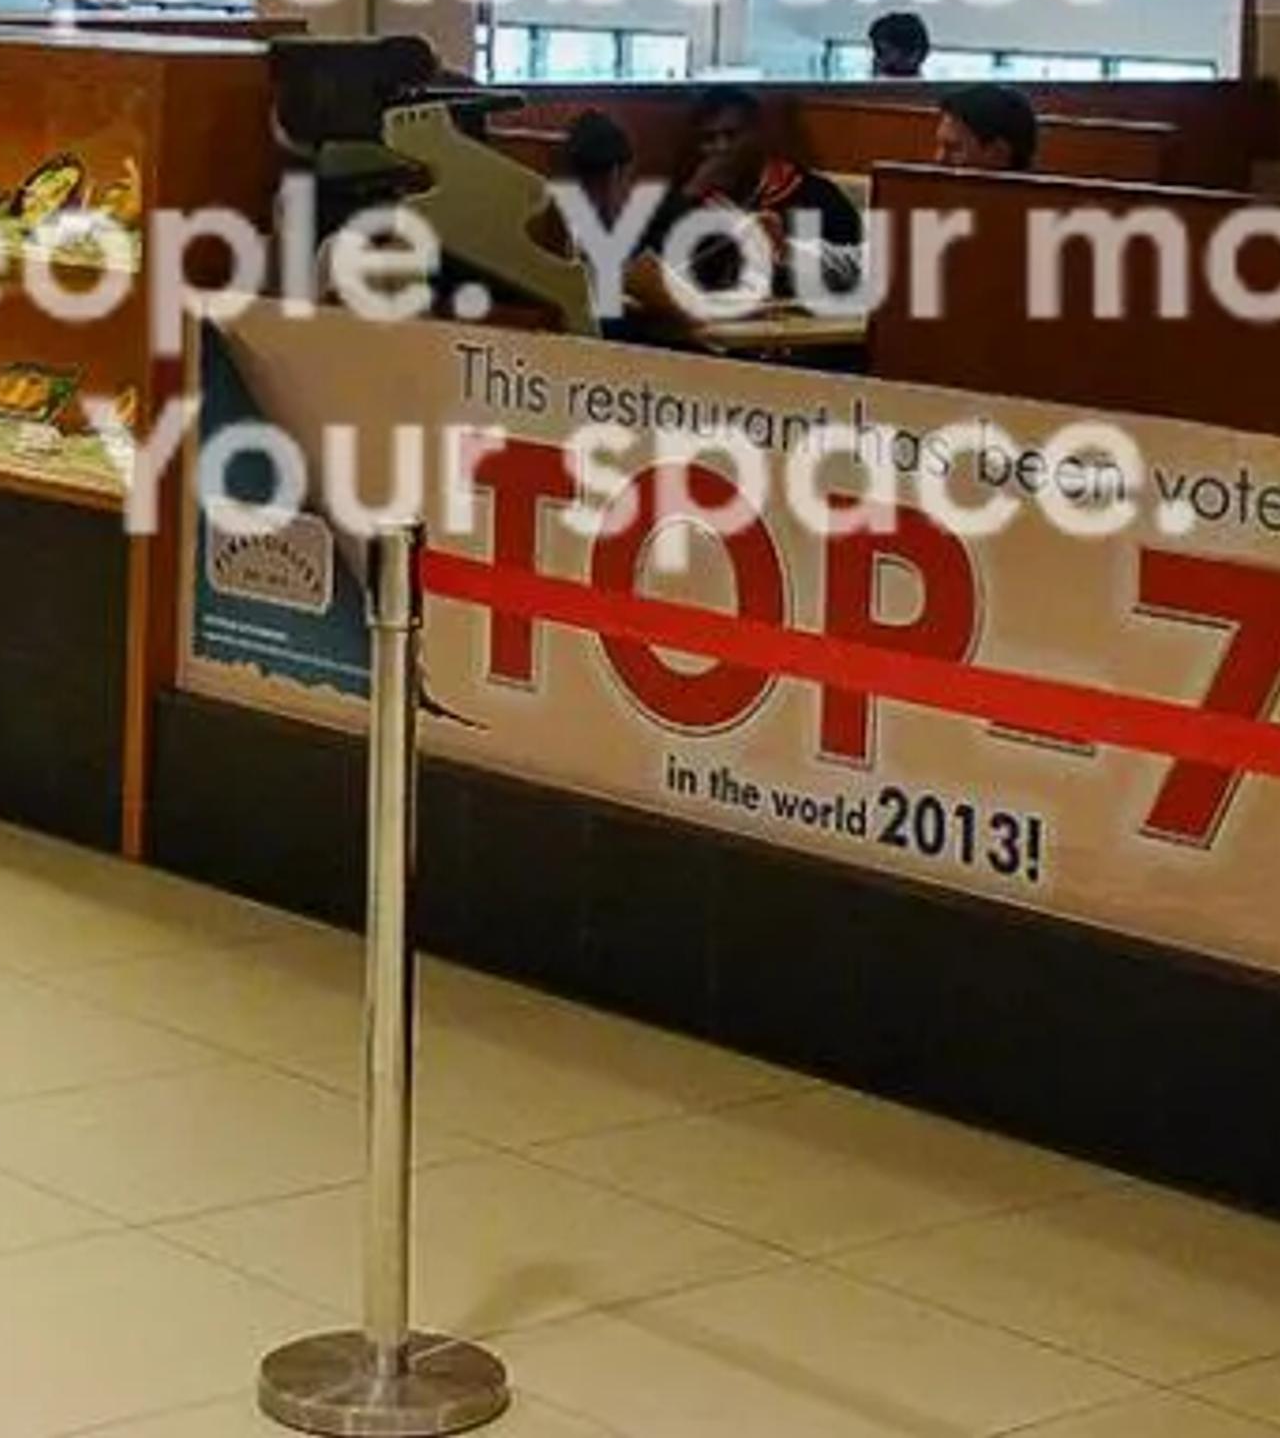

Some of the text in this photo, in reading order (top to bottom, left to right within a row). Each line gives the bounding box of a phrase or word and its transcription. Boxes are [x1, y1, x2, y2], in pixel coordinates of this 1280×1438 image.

[457, 343, 549, 413] This
[568, 378, 828, 454] restaurant
[853, 397, 949, 479] has
[976, 418, 1126, 507] been
[461, 430, 980, 767] TOP
[666, 755, 1043, 882] in the world 2013!
